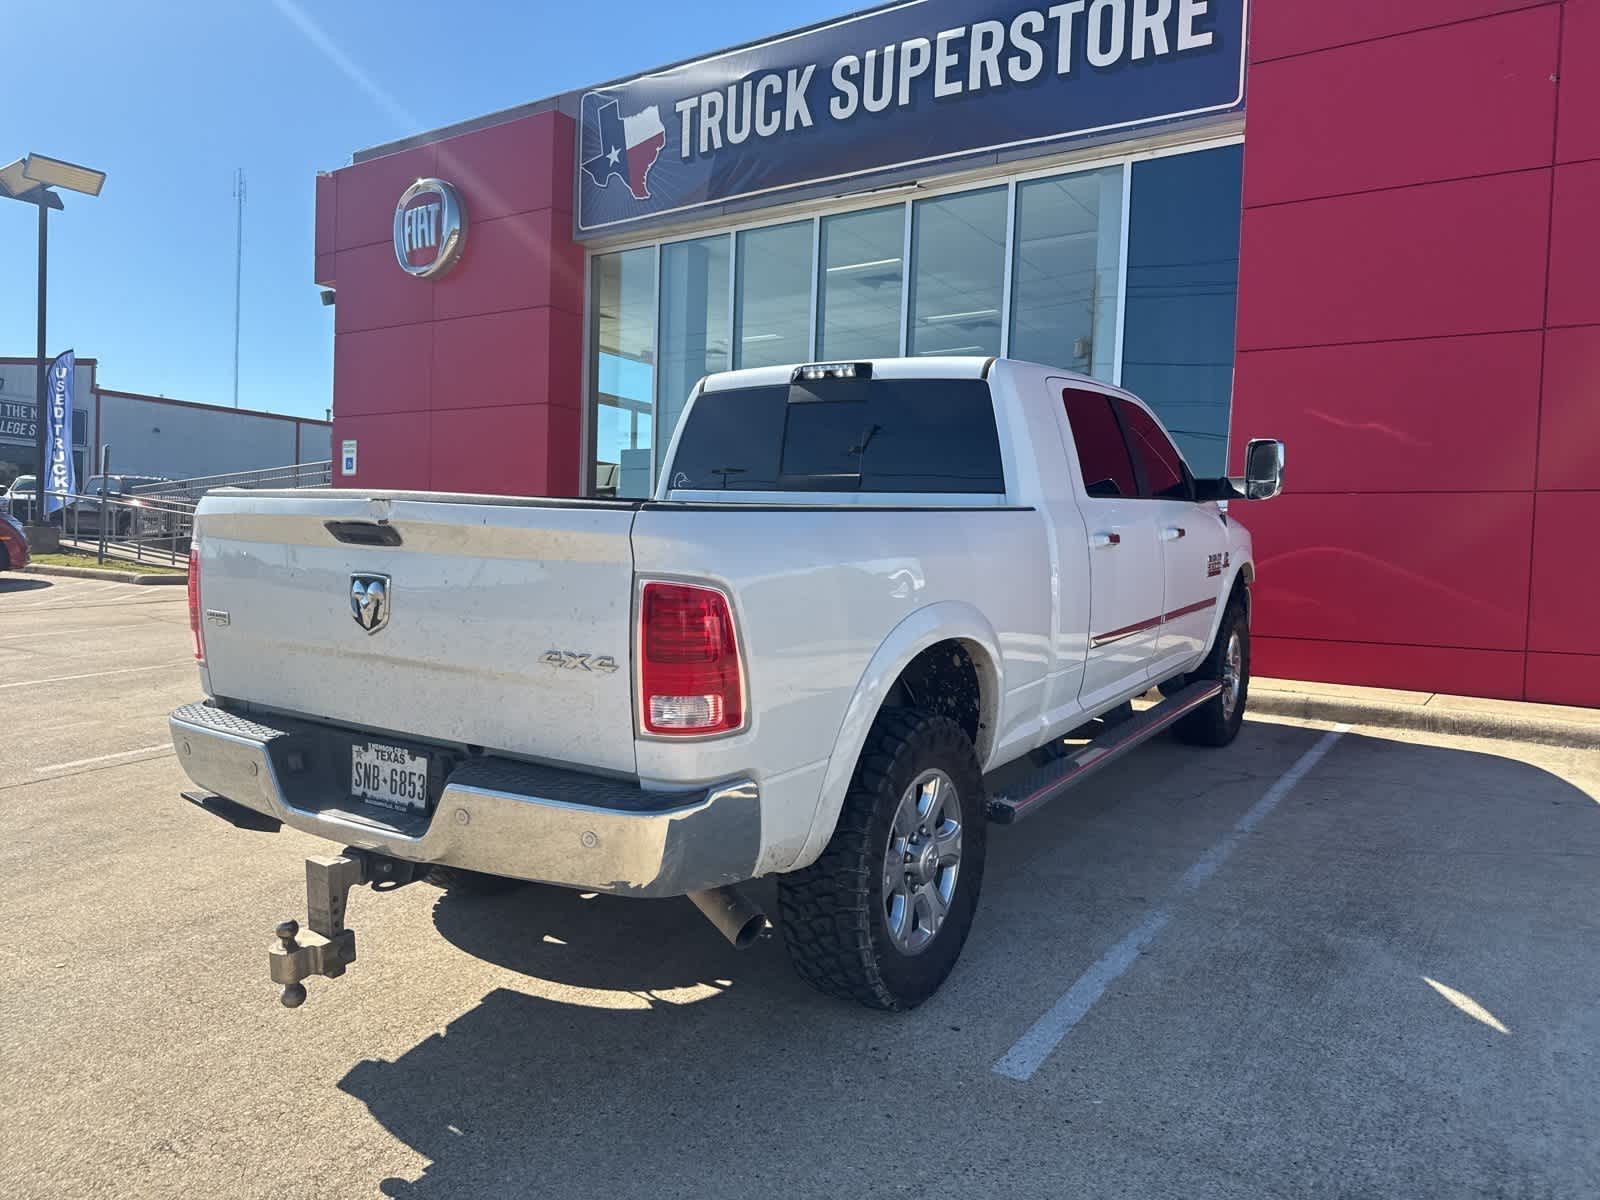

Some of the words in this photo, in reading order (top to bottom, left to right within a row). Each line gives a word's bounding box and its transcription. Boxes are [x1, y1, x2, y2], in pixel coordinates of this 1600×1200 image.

[675, 64, 816, 158] TRUCK
[829, 0, 1213, 120] SUPERSTORE
[404, 202, 440, 253] FIAT
[53, 367, 68, 418] USED
[0, 420, 28, 435] LEGE
[6, 404, 27, 418] THE
[374, 748, 406, 765] TEXAS
